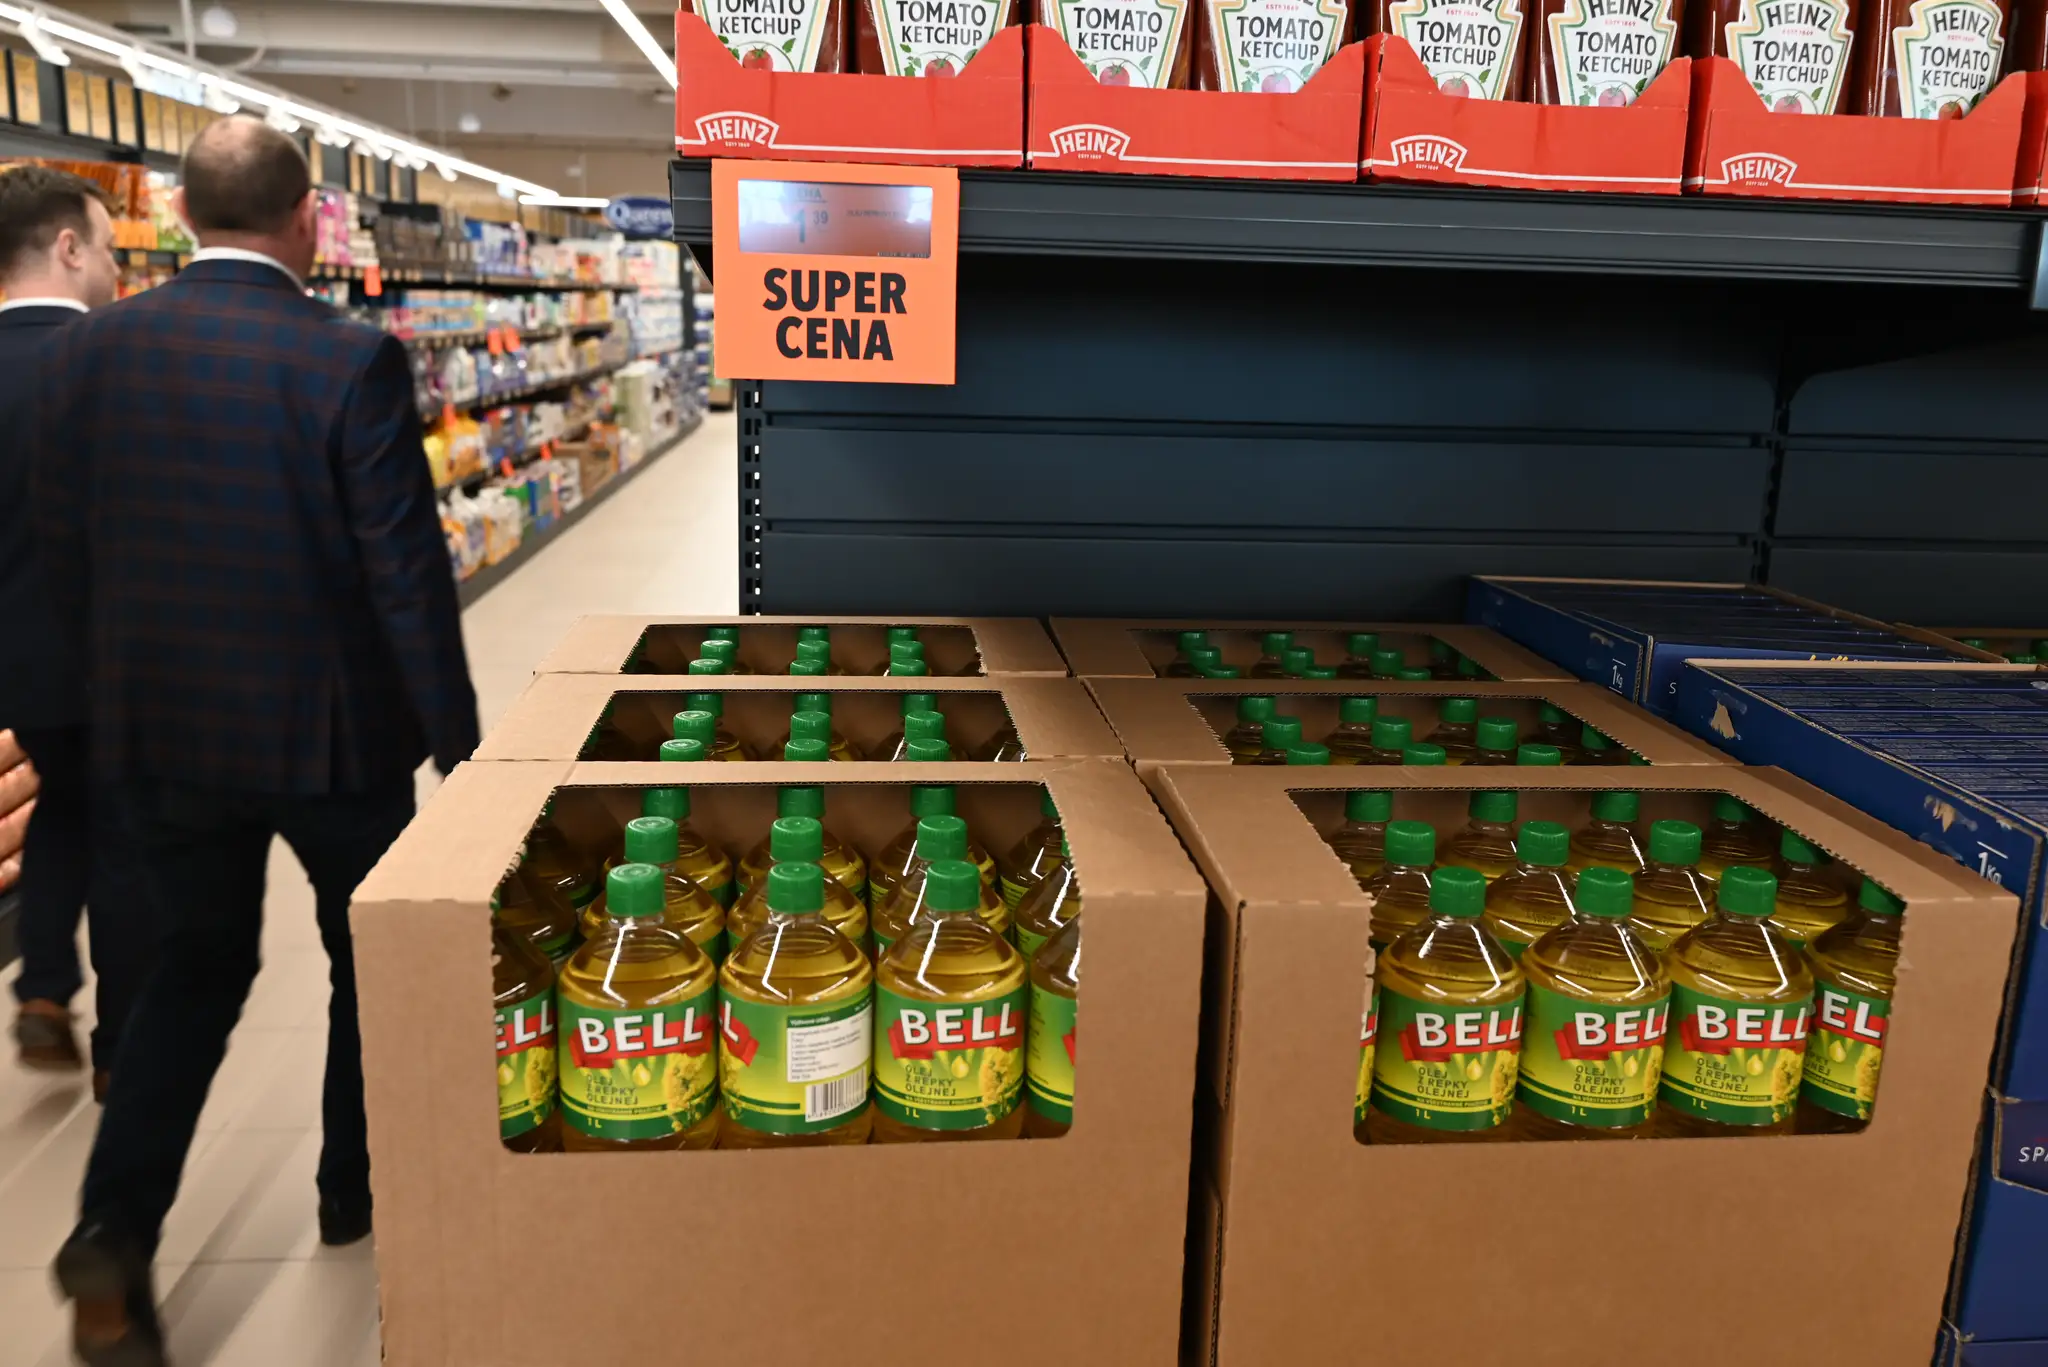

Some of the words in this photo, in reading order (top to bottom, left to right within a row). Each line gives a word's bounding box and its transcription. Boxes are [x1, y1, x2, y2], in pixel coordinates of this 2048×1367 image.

[896, 1, 986, 26] TOMATO
[1074, 7, 1162, 33] TOMATO
[1766, 4, 1832, 31] HEINZ
[1933, 9, 1990, 38] HEINZ
[719, 16, 801, 35] KETCHUP
[902, 26, 982, 46] KETCHUP
[1236, 16, 1323, 41] TOMATO
[1417, 21, 1501, 47] TOMATO
[1078, 32, 1158, 53] KETCHUP
[1240, 41, 1319, 61] KETCHUP
[1575, 31, 1657, 56] TOMATO
[1752, 40, 1834, 65] TOMATO
[1421, 46, 1496, 66] KETCHUP
[1579, 56, 1652, 76] KETCHUP
[1920, 46, 1990, 72] TOMATO
[1755, 64, 1829, 84] KETCHUP
[1921, 70, 1986, 90] KETCHUP
[705, 118, 770, 145] HEINZ
[1059, 131, 1121, 157] HEINZ
[1400, 142, 1459, 169] HEINZ
[1730, 159, 1788, 184] HEINZ
[813, 210, 829, 225] 39
[763, 267, 907, 314] SUPER
[776, 316, 894, 361] CENA
[577, 1007, 703, 1054] BELL
[900, 1002, 1017, 1044] BELL
[1416, 1006, 1521, 1047] BELL
[1574, 1002, 1669, 1046] BELL
[1696, 1004, 1807, 1042] BELL
[905, 1064, 932, 1077] OLEJ
[1418, 1067, 1448, 1079] OLEJ
[1576, 1065, 1606, 1076] OLEJ
[1697, 1057, 1727, 1071] OLEJ
[1428, 1079, 1468, 1089] REPKY
[1585, 1076, 1624, 1086] REPKY
[1694, 1075, 1749, 1092] OLEJNEJ
[1706, 1069, 1747, 1083] REPKY
[586, 1093, 638, 1105] OLEJNEJ
[905, 1083, 956, 1096] OLEJNEJ
[1417, 1086, 1470, 1098] OLEJNEJ
[1574, 1083, 1626, 1095] OLEJNEJ
